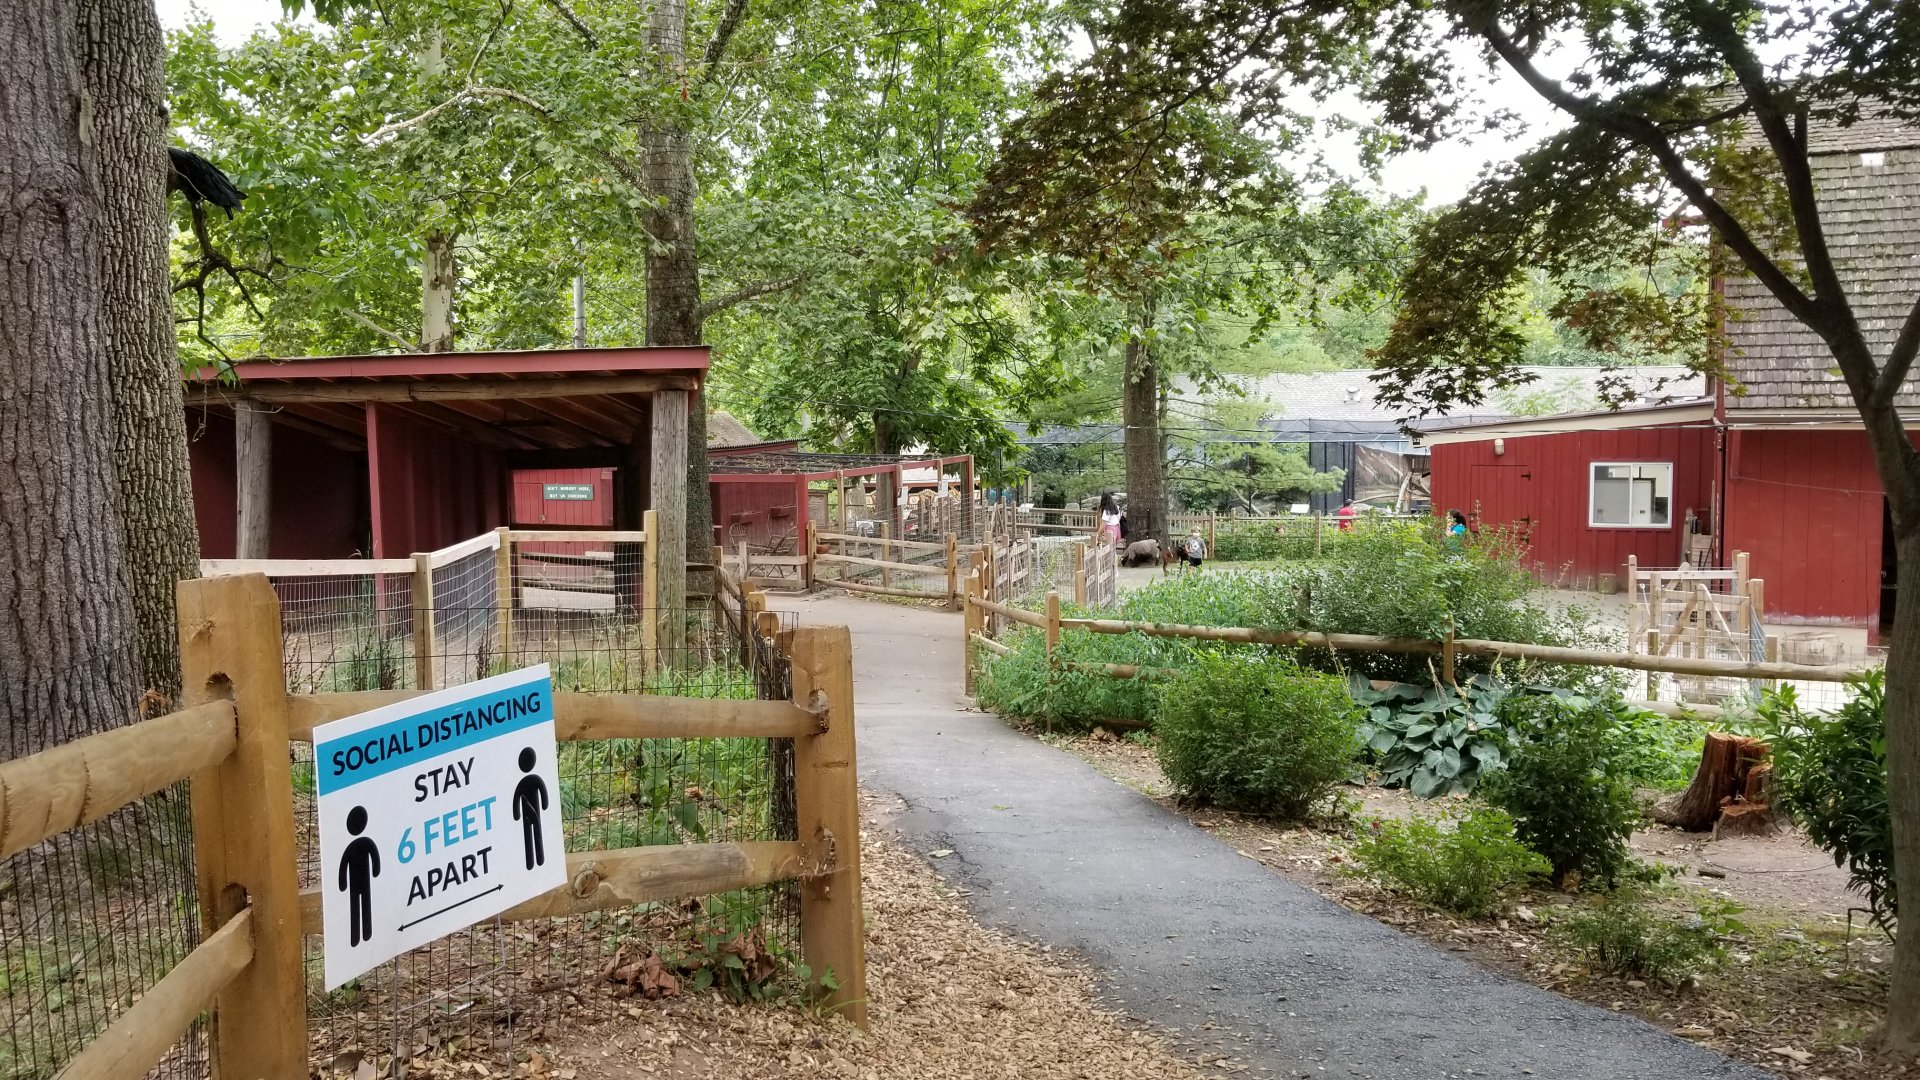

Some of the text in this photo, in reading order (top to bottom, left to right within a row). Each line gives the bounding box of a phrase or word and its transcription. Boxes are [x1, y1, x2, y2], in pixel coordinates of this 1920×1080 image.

[332, 691, 541, 776] SOCIAL DISTANCING
[414, 757, 475, 803] STAY
[397, 796, 497, 864] 6 FEET
[406, 845, 492, 907] APART
